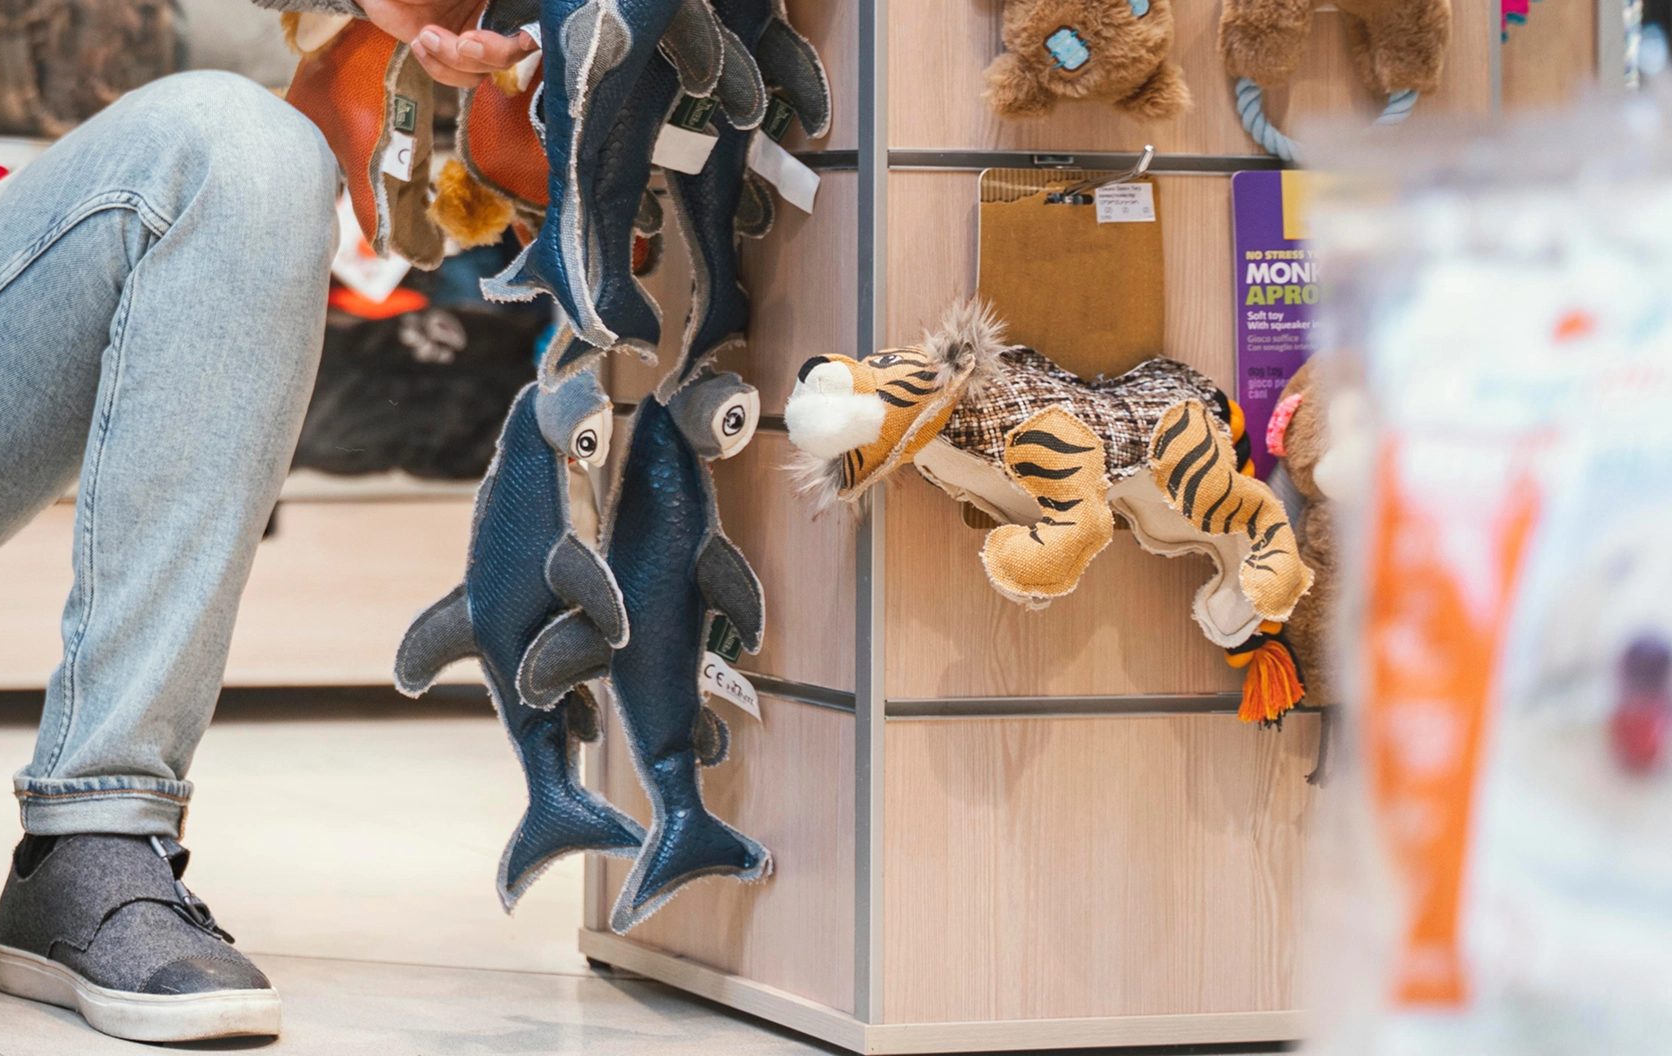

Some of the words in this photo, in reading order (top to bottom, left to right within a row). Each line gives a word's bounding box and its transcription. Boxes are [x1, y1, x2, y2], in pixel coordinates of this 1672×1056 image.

[1246, 250, 1264, 260] NO
[1265, 249, 1305, 260] STRESS
[1246, 261, 1319, 284] MONK
[1245, 284, 1321, 306] APRO
[1247, 310, 1267, 321] Soft
[1268, 311, 1285, 322] toy
[1247, 321, 1269, 330] With
[1270, 320, 1311, 332] squeaker
[1247, 335, 1271, 343] Gioco
[1273, 334, 1300, 343] soffice
[1263, 344, 1293, 353] sonaglio
[1248, 379, 1273, 390] gioco
[1248, 390, 1268, 400] cani
